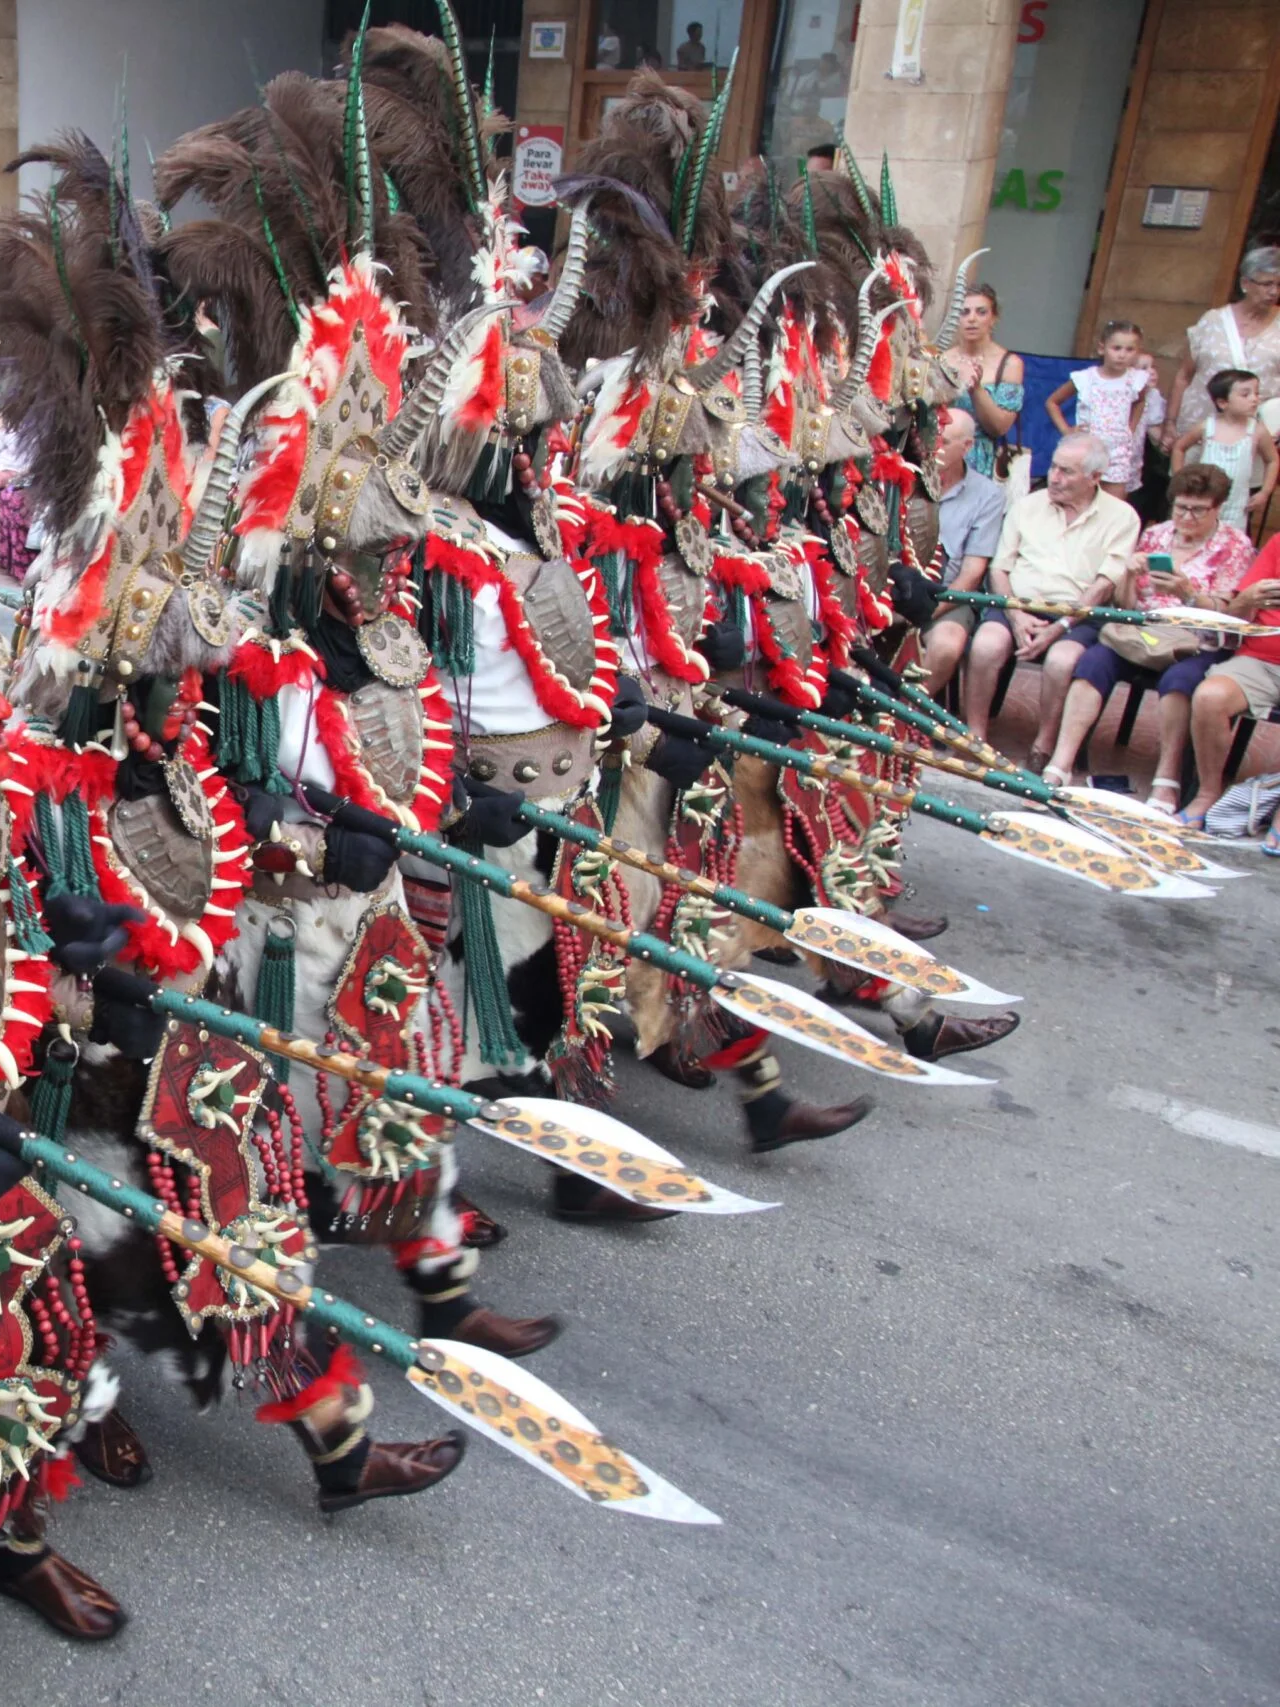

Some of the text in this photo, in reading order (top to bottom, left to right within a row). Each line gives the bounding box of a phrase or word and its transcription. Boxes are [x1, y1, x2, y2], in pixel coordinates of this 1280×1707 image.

[527, 148, 552, 158] Para
[523, 158, 554, 169] llevar
[523, 170, 553, 181] Take
[520, 181, 553, 192] away
